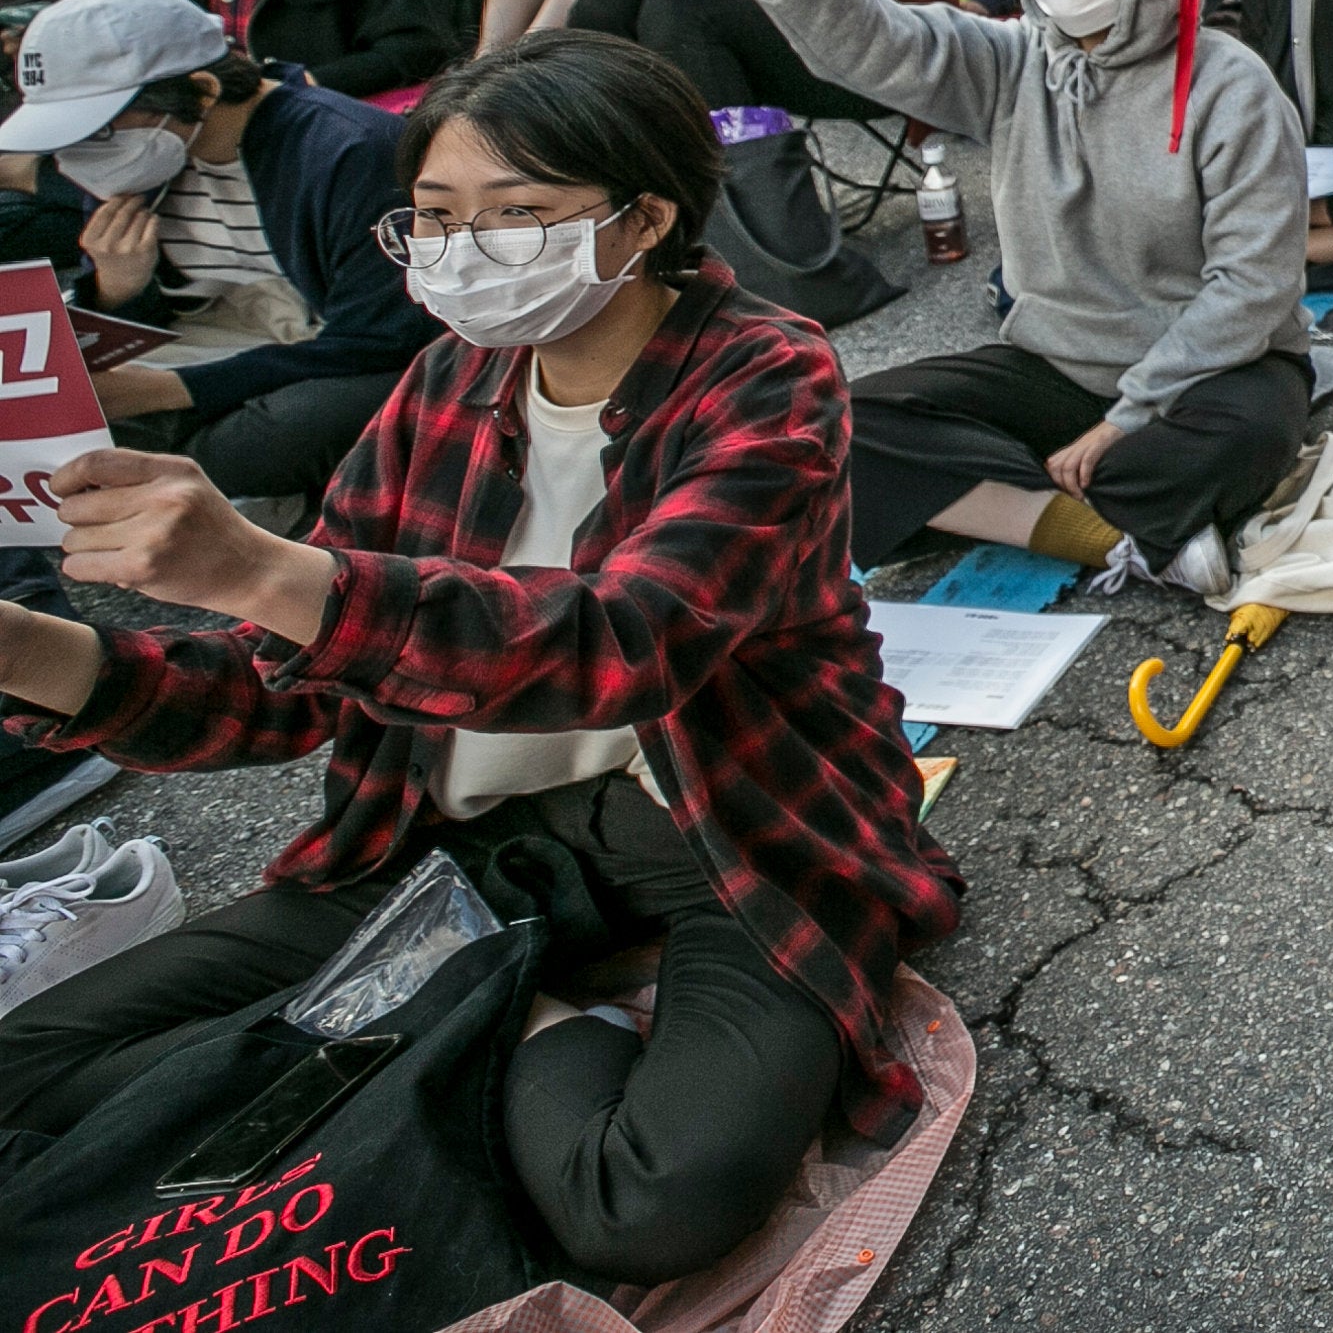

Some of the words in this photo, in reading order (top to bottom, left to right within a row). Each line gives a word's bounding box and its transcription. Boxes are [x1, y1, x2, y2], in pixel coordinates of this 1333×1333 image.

[24, 1242, 202, 1333] CAN
[215, 1182, 335, 1266] DO
[75, 1152, 323, 1269] GIRLS
